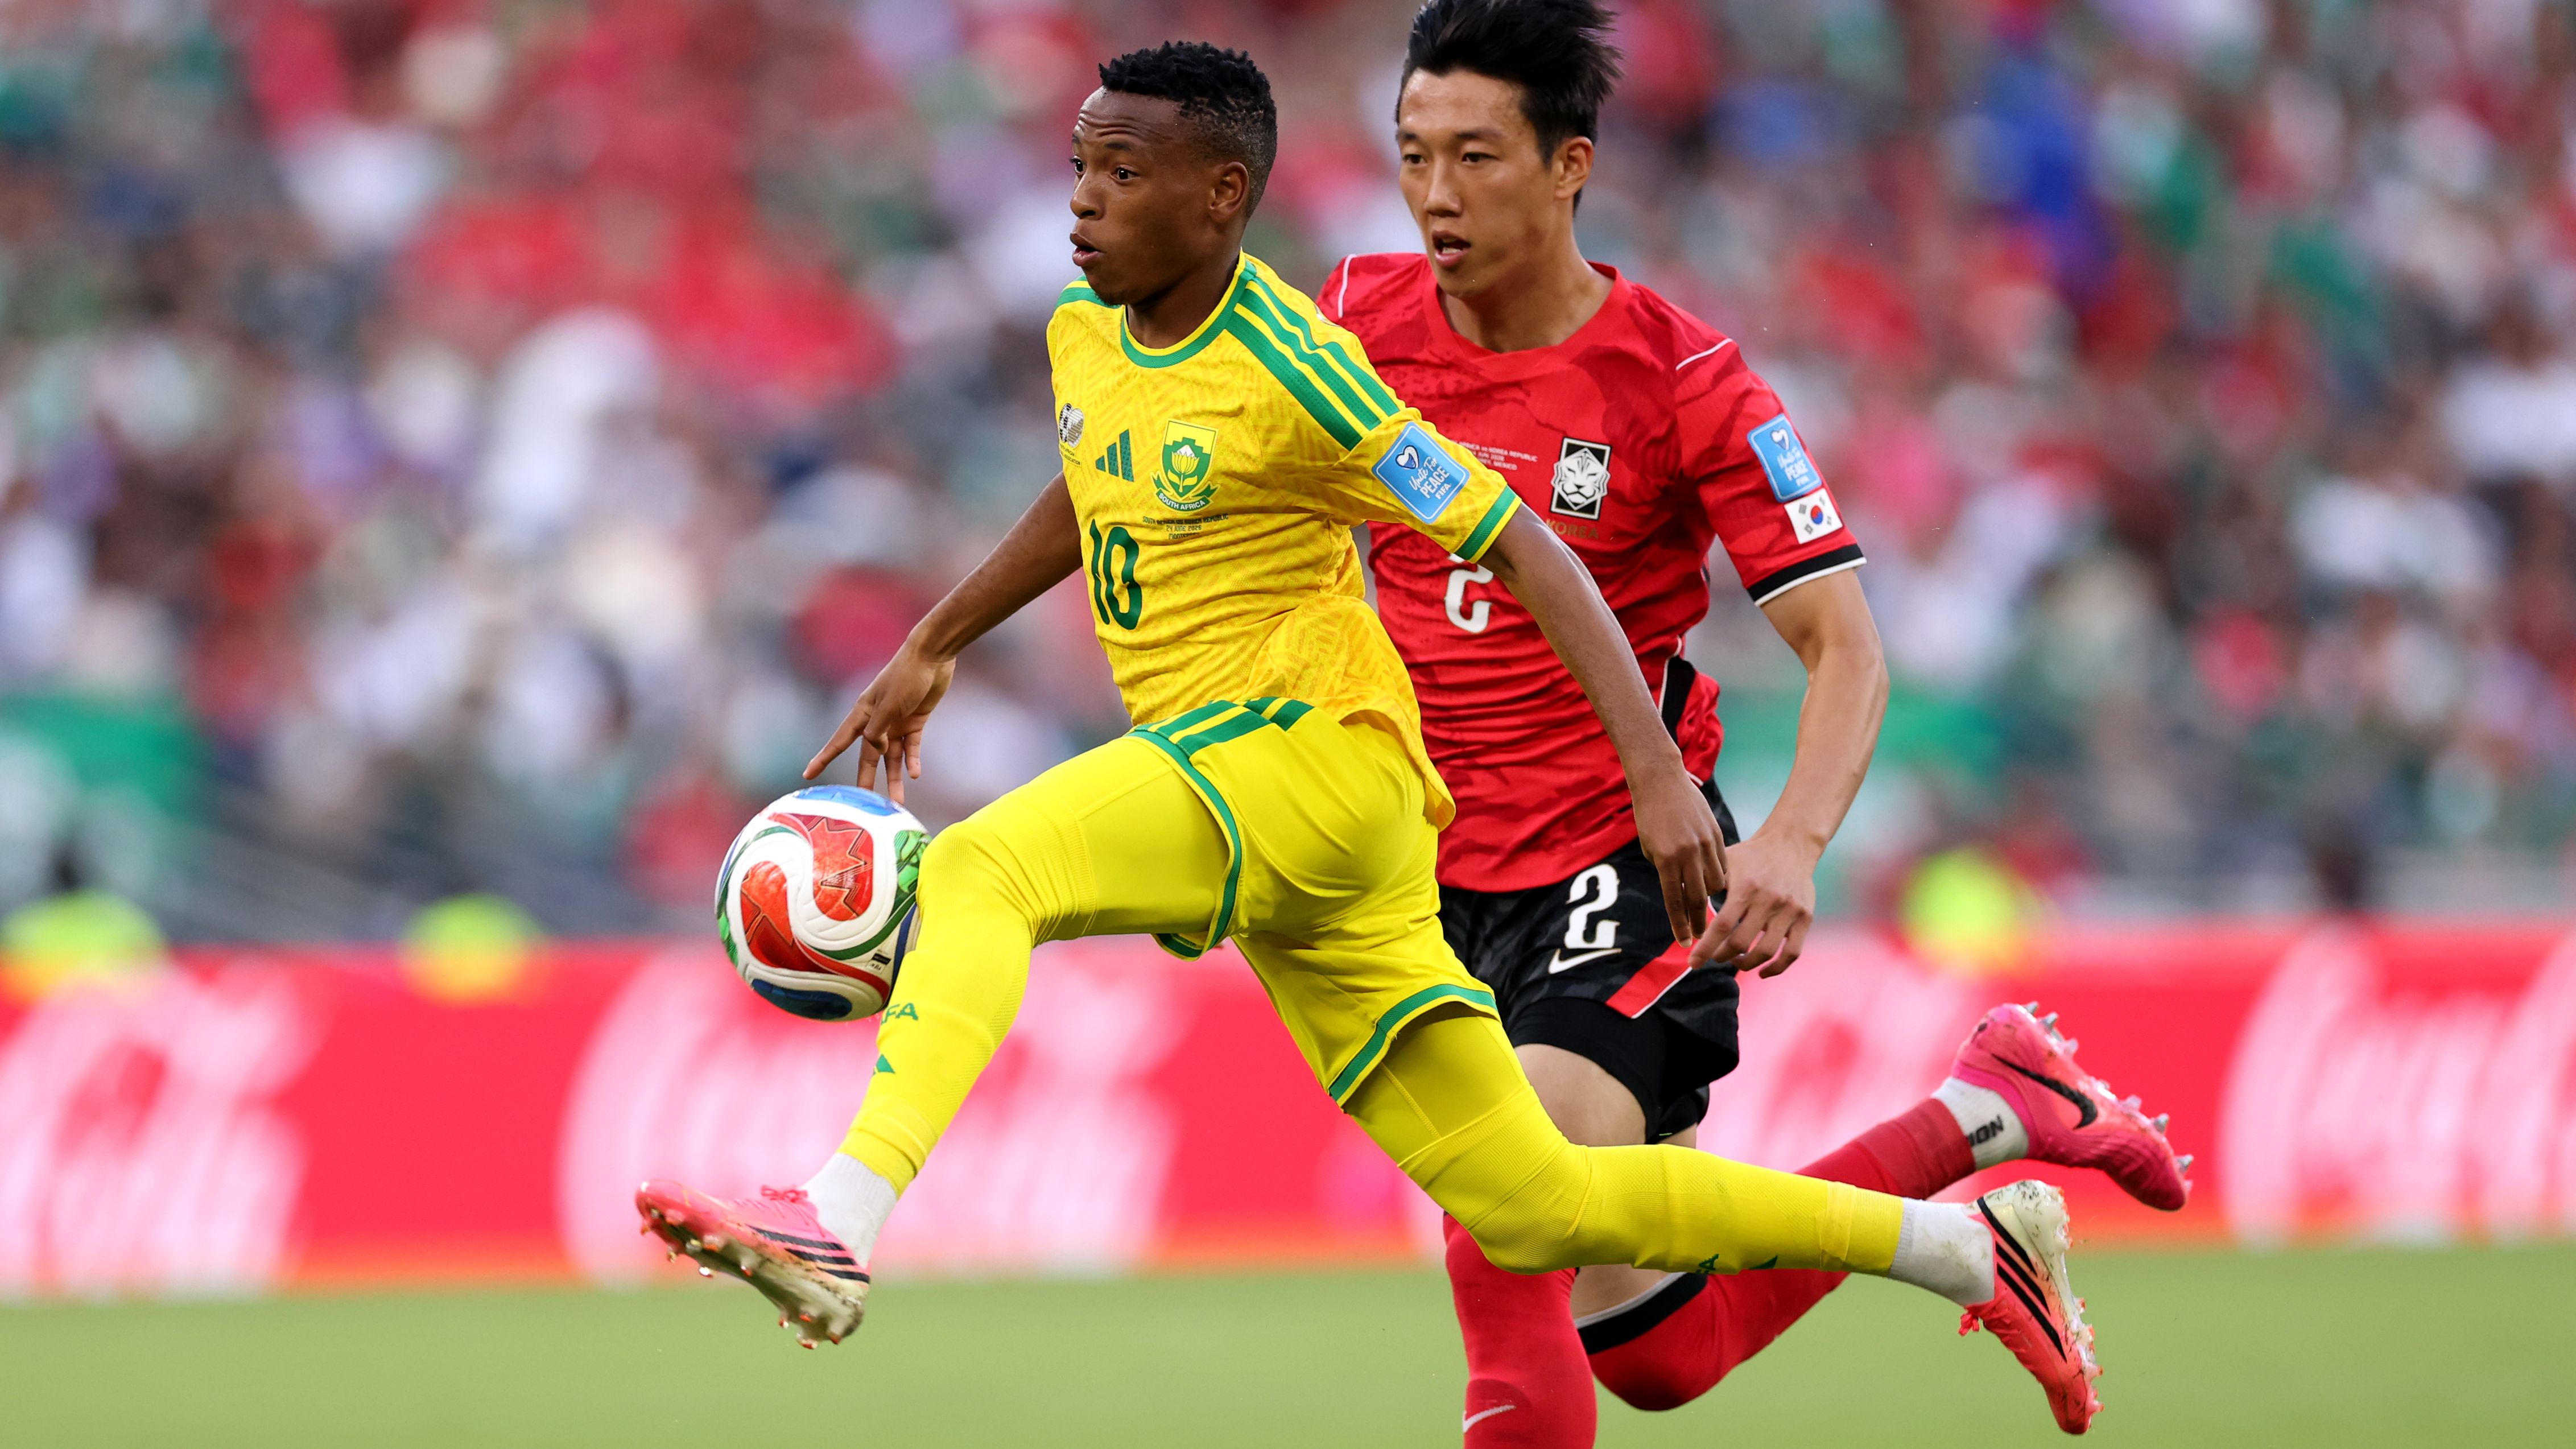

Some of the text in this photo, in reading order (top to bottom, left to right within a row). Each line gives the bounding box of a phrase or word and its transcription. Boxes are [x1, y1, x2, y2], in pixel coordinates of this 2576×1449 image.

[1408, 456, 1438, 490] Unite For
[1419, 466, 1450, 499] PEACE
[1159, 493, 1206, 510] SOUTH AFRICA
[1435, 483, 1452, 499] FIFA
[1142, 516, 1155, 525] SOUTH
[1203, 514, 1229, 523] REPUBLIC
[1546, 518, 1599, 539] KOREA
[1089, 518, 1142, 630] 10
[1564, 864, 1620, 949] 2
[881, 1002, 919, 1026] FA
[1966, 1114, 2004, 1148] ION
